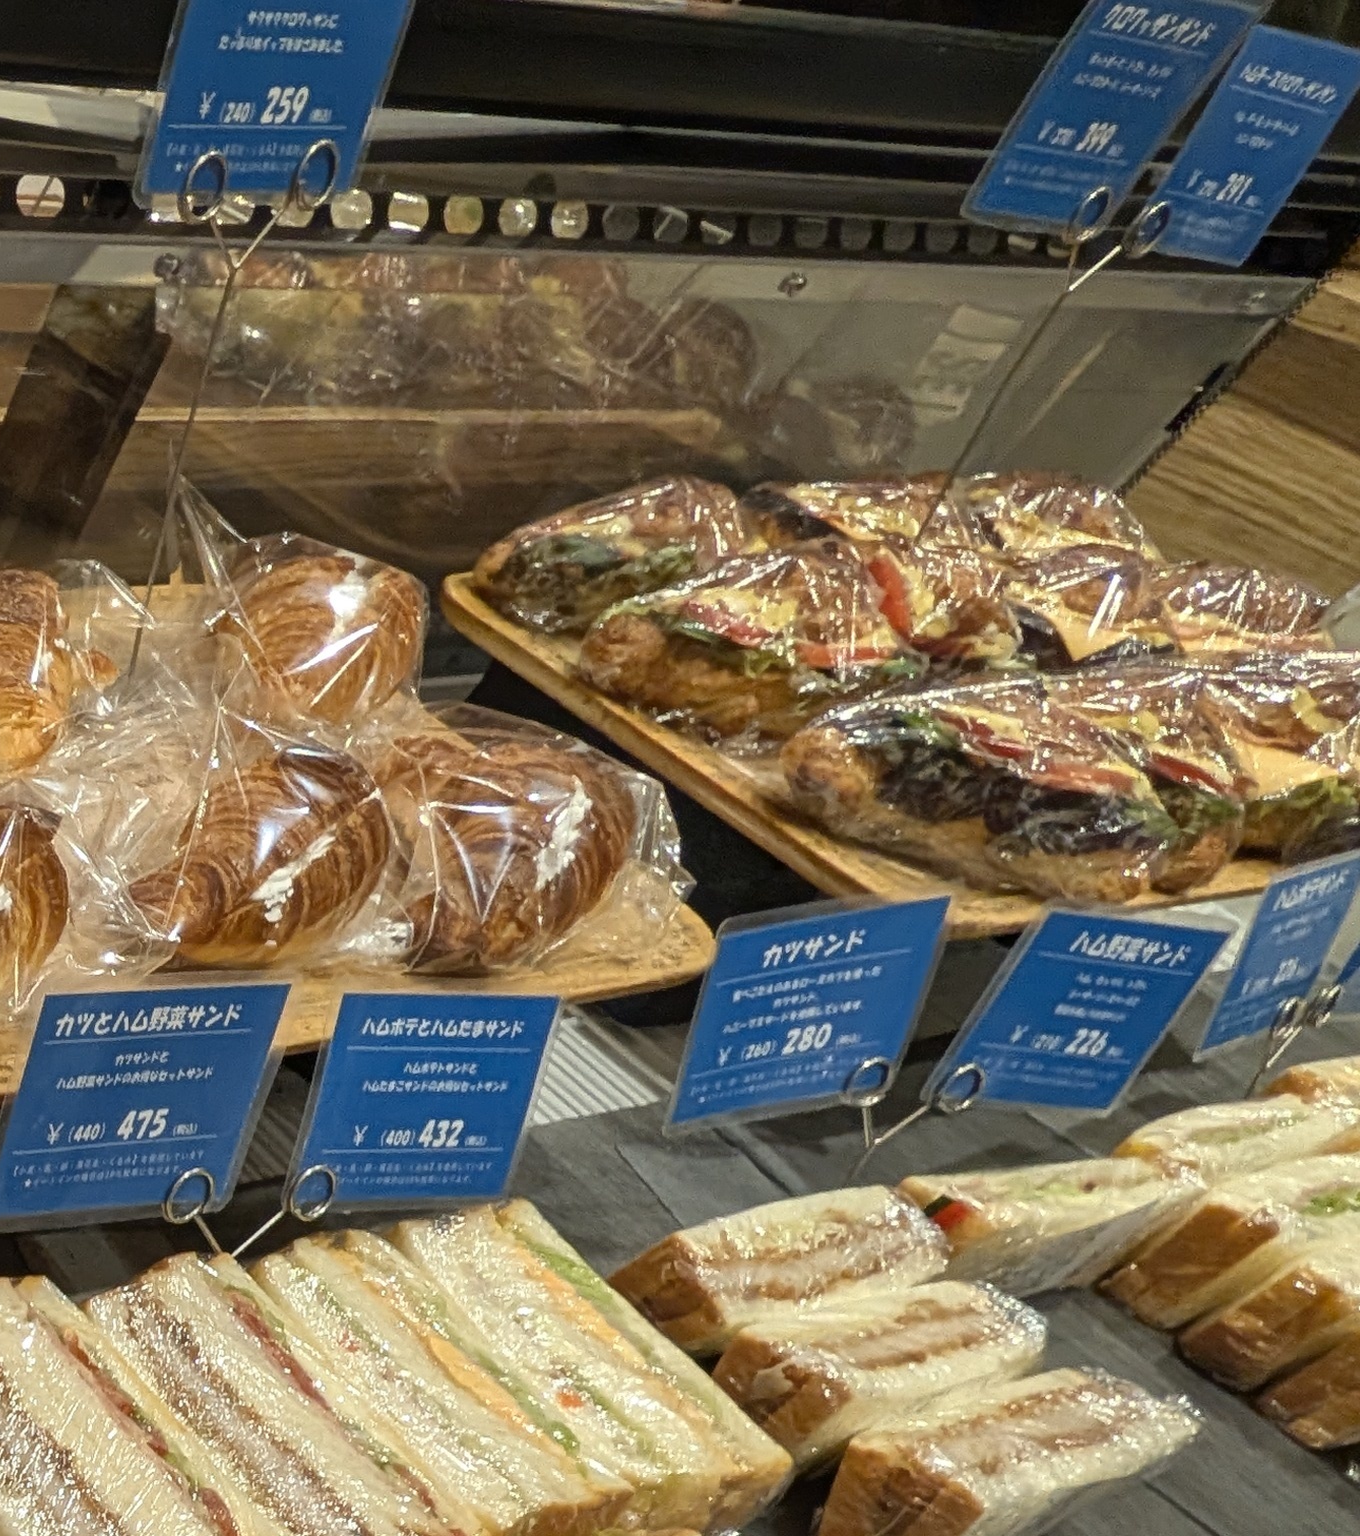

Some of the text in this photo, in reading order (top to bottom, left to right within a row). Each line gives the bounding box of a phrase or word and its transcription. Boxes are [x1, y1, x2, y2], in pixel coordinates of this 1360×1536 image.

[199, 91, 216, 119] ¥
[220, 101, 256, 123] (240)
[260, 86, 309, 124] 259
[762, 929, 867, 968] カツサンド
[55, 1003, 242, 1037] カツとハム野菜サンド
[781, 1022, 833, 1056] 280
[1064, 1027, 1110, 1057] 226
[115, 1050, 170, 1066] カツサンドと
[48, 1122, 64, 1145] ¥
[68, 1124, 105, 1142] (440)
[117, 1108, 169, 1140] 475
[353, 1125, 368, 1146] ¥
[380, 1129, 416, 1146] (400)
[418, 1119, 464, 1148] 432
